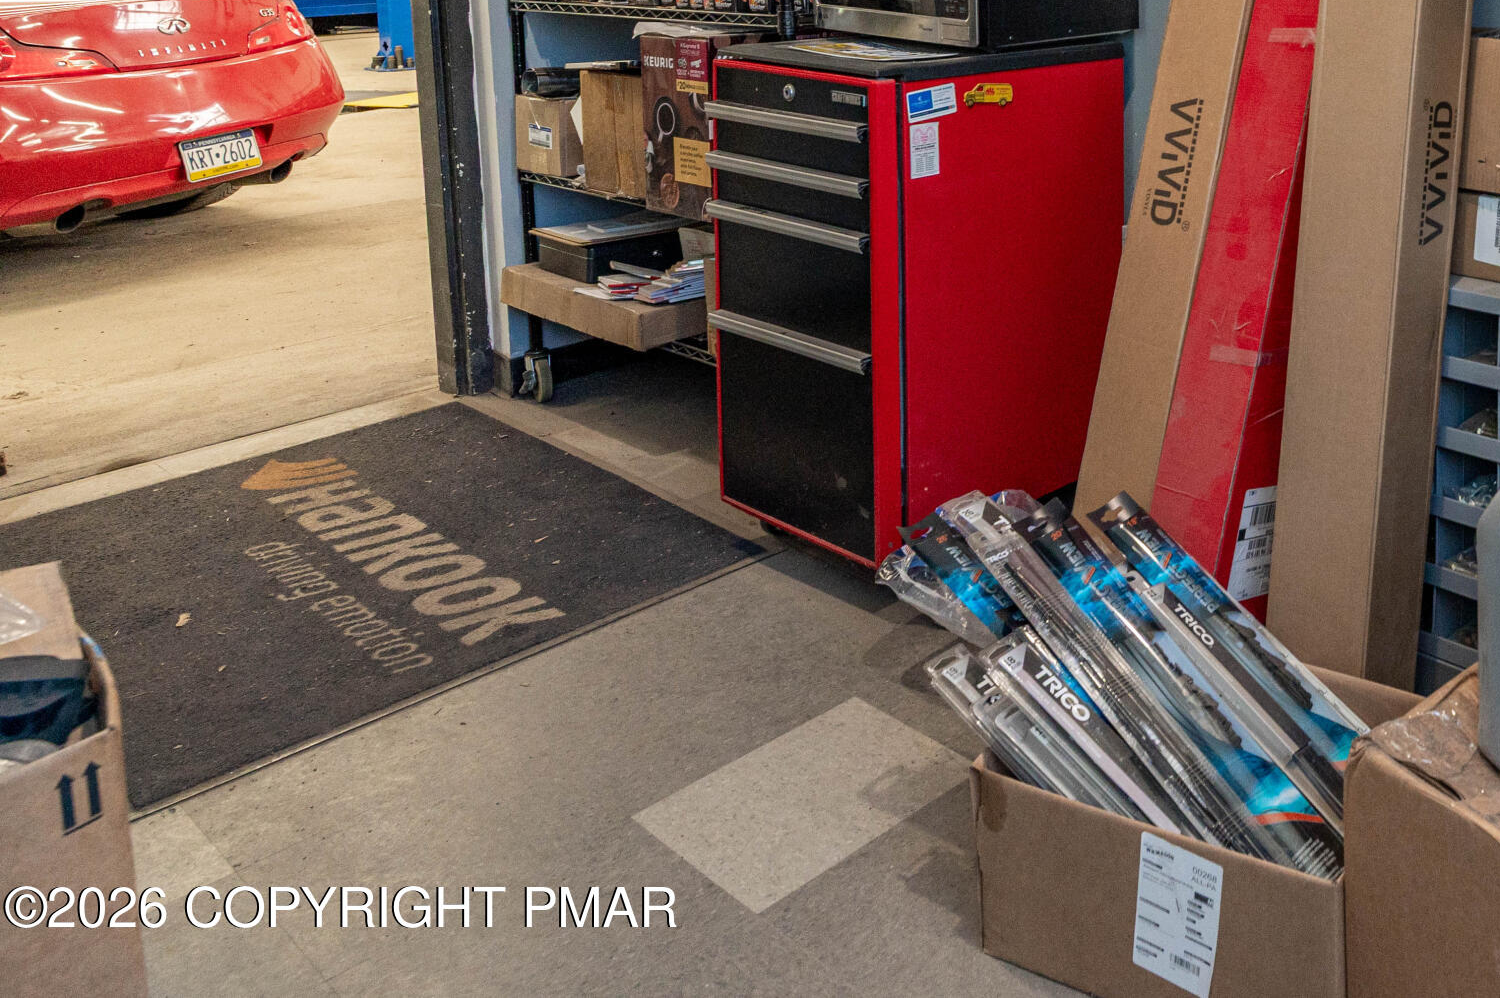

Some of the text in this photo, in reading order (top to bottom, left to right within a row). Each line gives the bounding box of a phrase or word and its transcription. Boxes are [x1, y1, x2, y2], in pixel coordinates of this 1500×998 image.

[644, 55, 674, 69] KEURIG
[946, 545, 984, 584] VIEW
[1060, 542, 1096, 585] VIEW
[1136, 529, 1172, 568] VIEW
[243, 540, 435, 676] driving emotion
[1174, 603, 1215, 646] TRICO
[1035, 664, 1091, 722] TRICO
